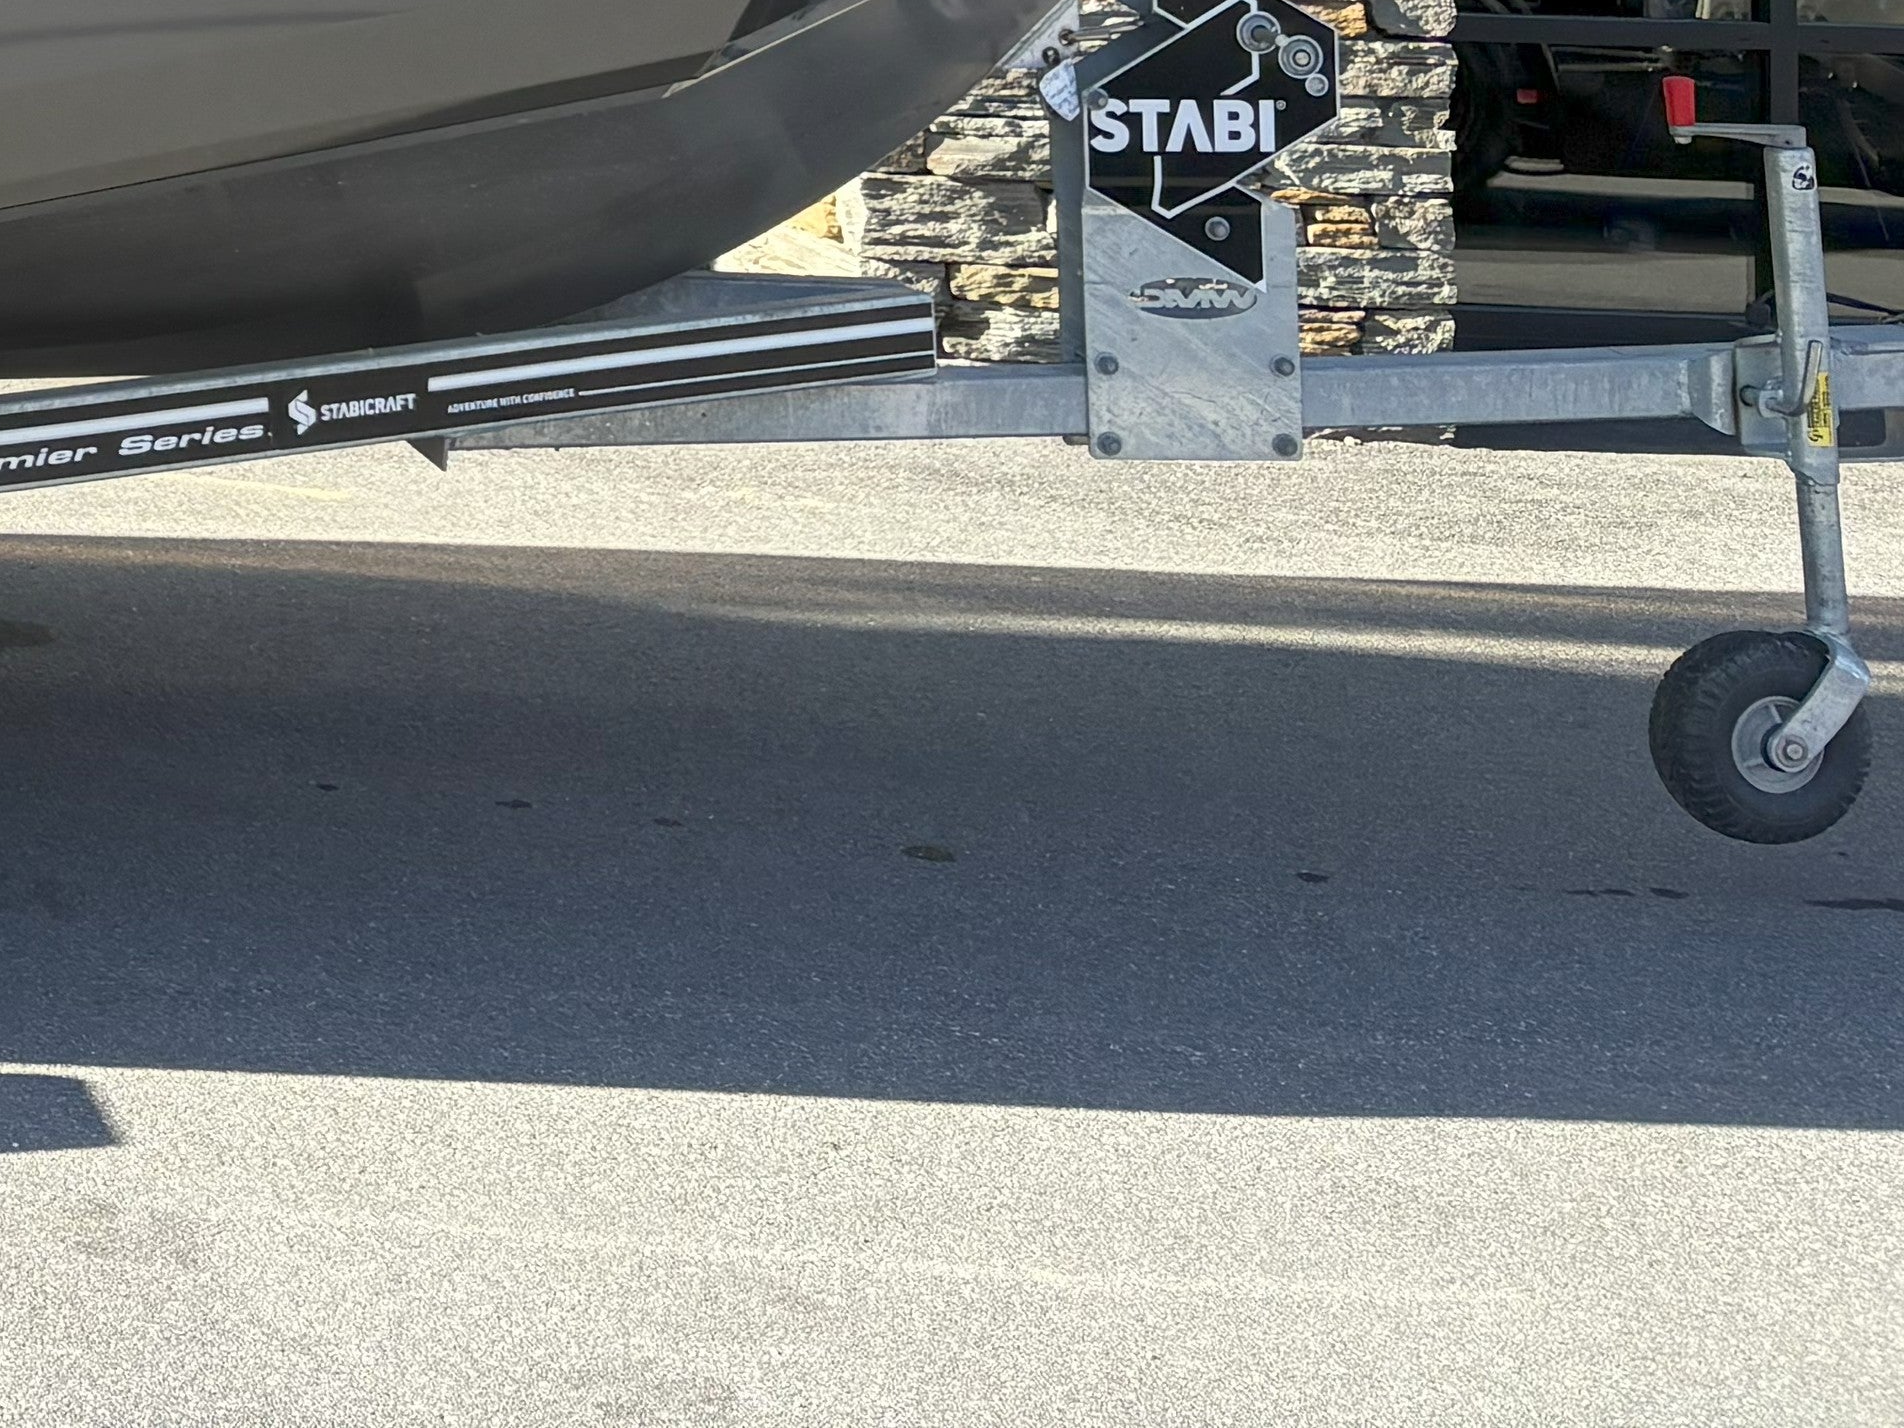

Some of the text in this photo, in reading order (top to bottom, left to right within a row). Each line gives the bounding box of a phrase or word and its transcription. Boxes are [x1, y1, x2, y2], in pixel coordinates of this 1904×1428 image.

[1090, 97, 1276, 154] STABI
[320, 392, 417, 422] STABICRAFT
[446, 387, 576, 415] ADVENTURE WITH CONFIDENCE
[117, 423, 265, 456] Series
